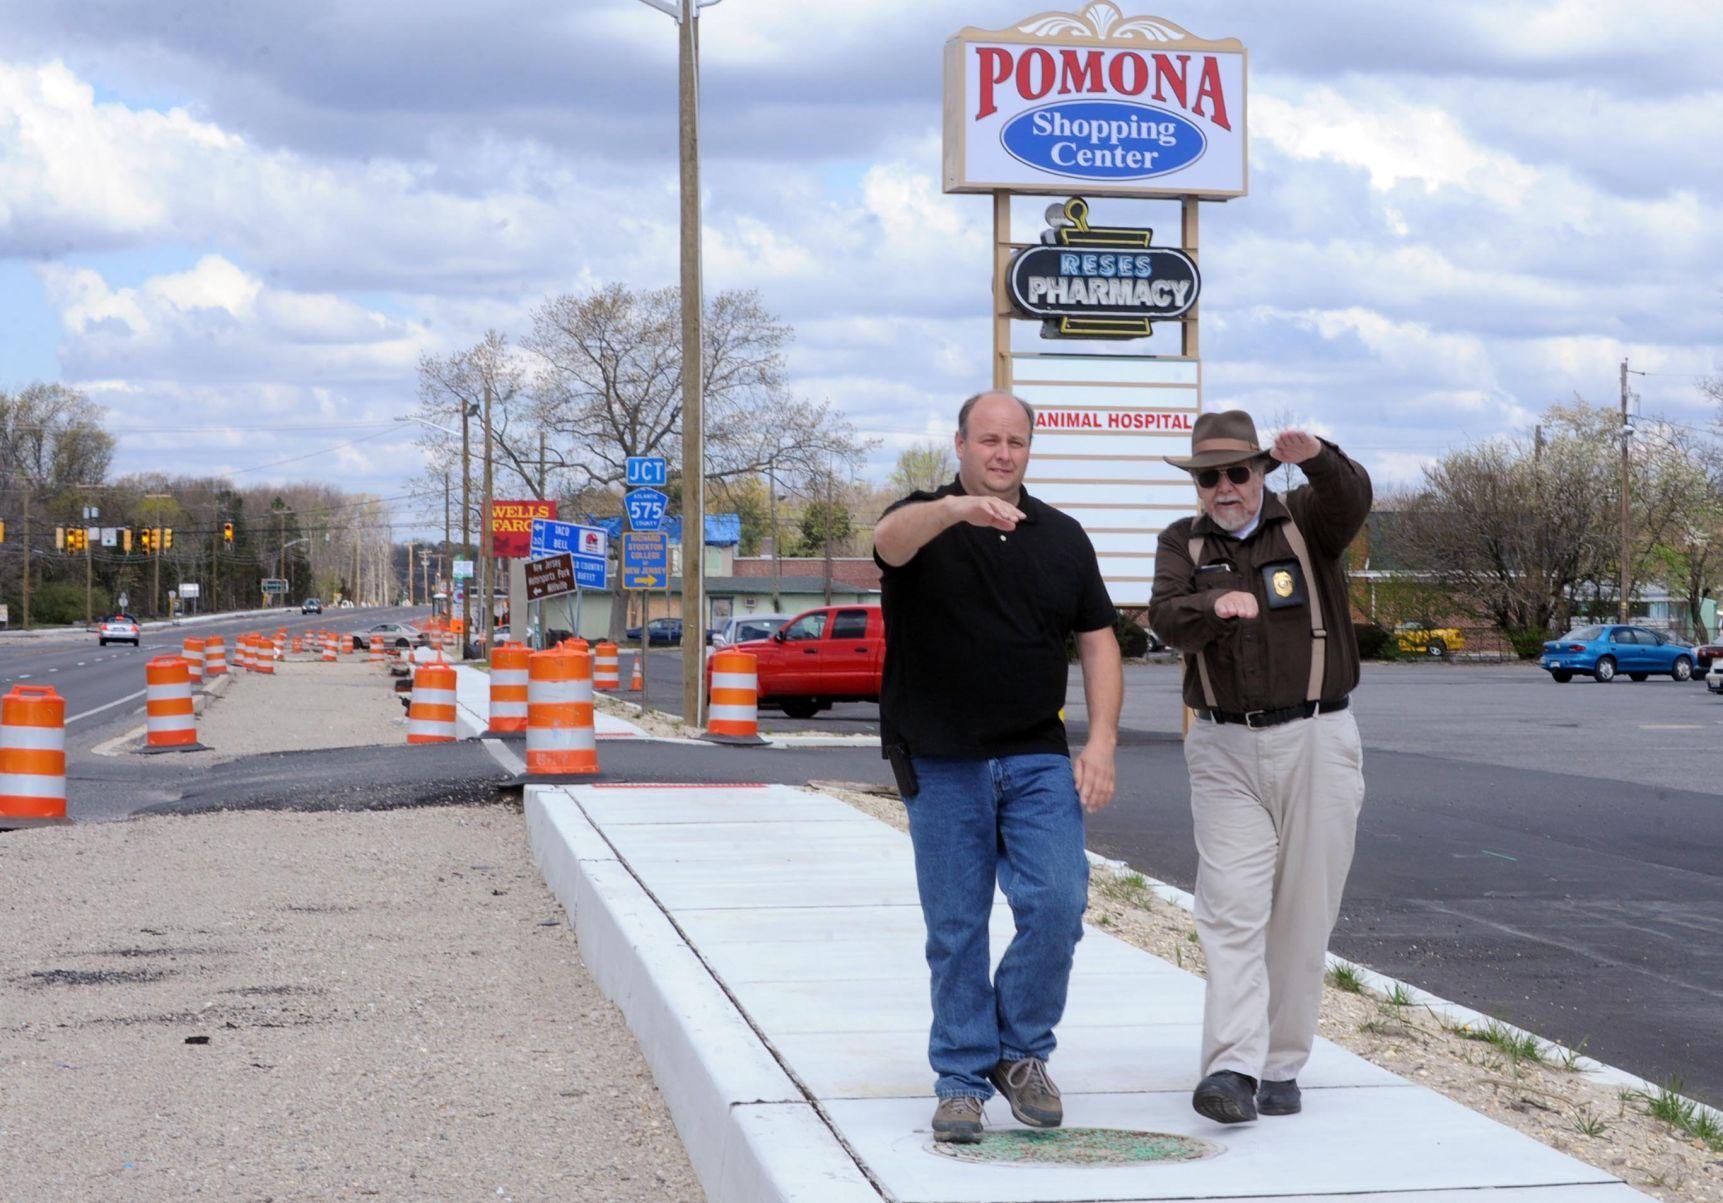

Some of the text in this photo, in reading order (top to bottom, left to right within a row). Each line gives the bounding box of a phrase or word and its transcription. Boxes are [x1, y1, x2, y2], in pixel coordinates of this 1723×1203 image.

[975, 47, 1232, 132] POMONA
[1032, 111, 1177, 147] Shopping
[1051, 142, 1159, 169] Center
[1060, 253, 1152, 277] RESES
[1028, 276, 1191, 307] PHARMACY
[1035, 412, 1193, 430] ANIMAL HOSPITAL
[630, 461, 663, 480] JCT
[492, 505, 549, 518] WELLS
[631, 502, 662, 519] 575
[492, 519, 532, 532] FARG
[555, 525, 570, 536] TACO
[553, 539, 568, 550] BELL
